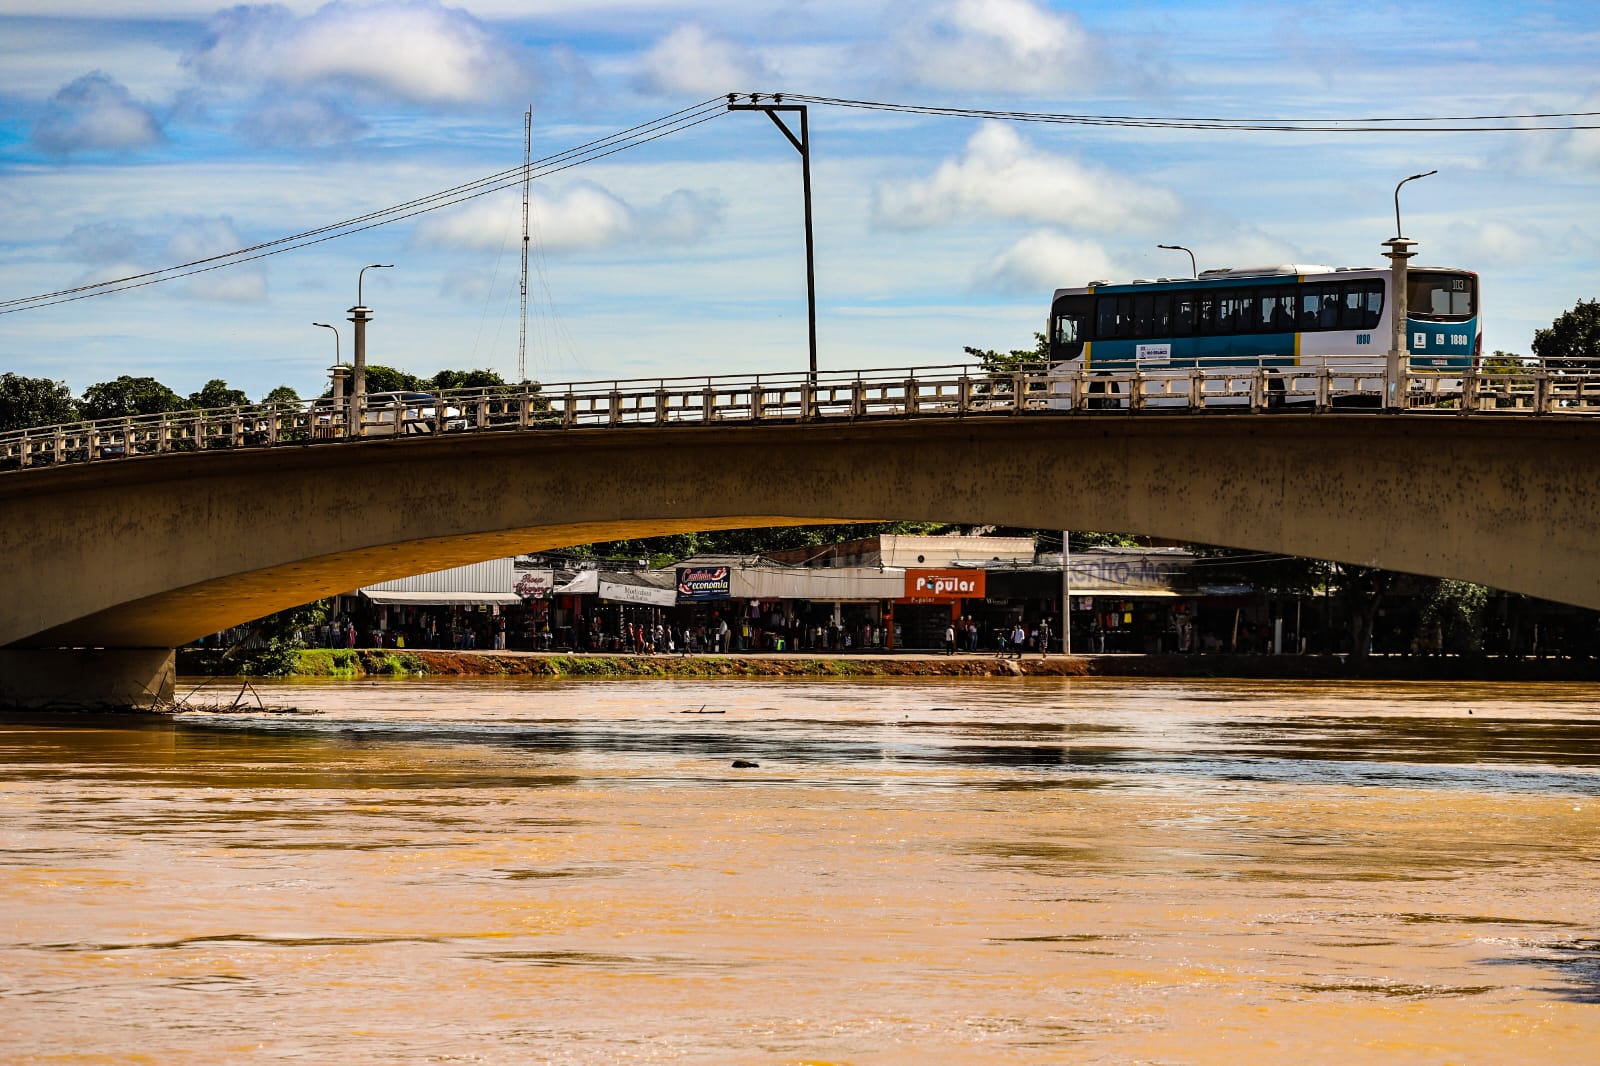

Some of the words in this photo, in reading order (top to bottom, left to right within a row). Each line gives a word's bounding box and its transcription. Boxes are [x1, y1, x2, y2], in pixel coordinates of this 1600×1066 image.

[1450, 334, 1468, 346] 1880
[692, 580, 728, 590] economia
[916, 577, 975, 595] Popular
